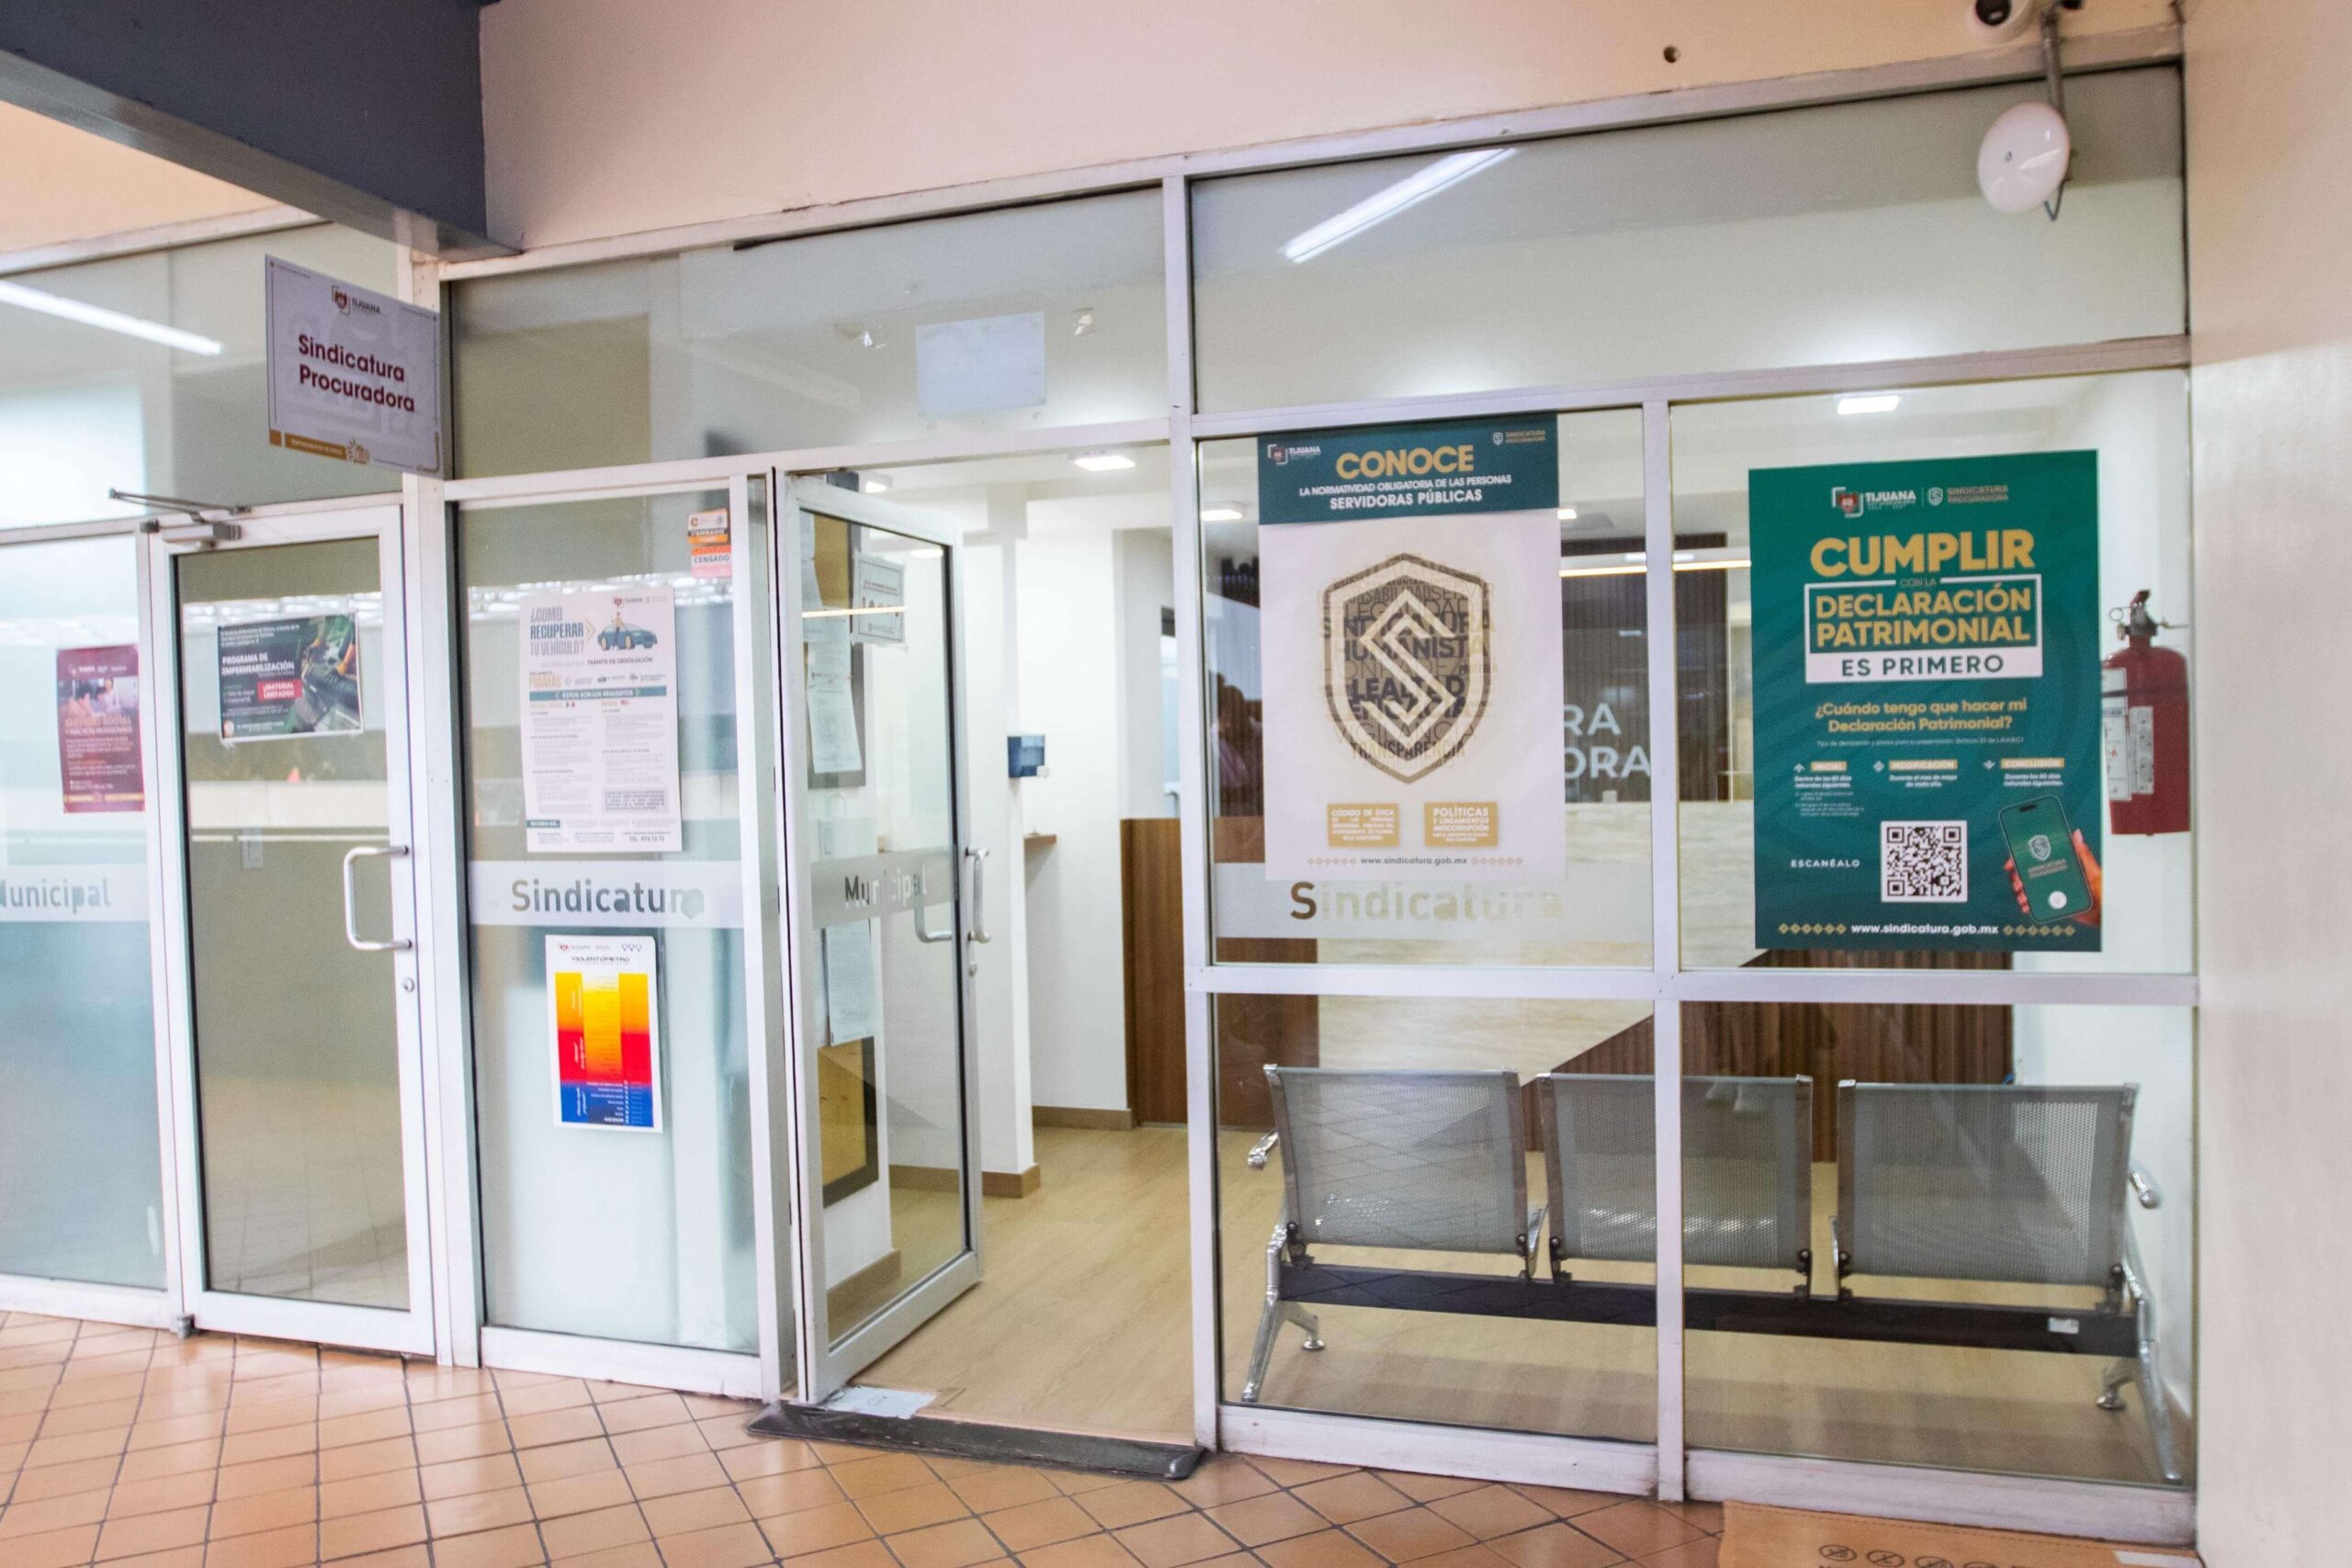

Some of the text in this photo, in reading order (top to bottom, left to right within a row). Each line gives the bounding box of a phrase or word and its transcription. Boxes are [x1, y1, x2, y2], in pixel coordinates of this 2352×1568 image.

[298, 333, 405, 382] Sindicatura
[299, 364, 415, 412] Procuradora
[1288, 446, 1321, 456] TIJUANA
[1336, 445, 1475, 479] CONOCE
[1299, 474, 1512, 497] LA NORMATIVIDAD OBLIGATORIA DE LAS PERSONAS
[1947, 485, 2009, 495] SINDICATURA
[1329, 488, 1484, 510] SERVIDORAS PÚBLICAS
[1865, 490, 1917, 503] TIJUANA
[694, 555, 729, 564] CENSADO
[1809, 528, 2036, 578] CUMPLIR
[1899, 577, 1938, 587] CON LA
[1815, 581, 2031, 619] DECLARACIÓN
[530, 622, 584, 640] RECUPERAR
[1815, 615, 2030, 649] PATRIMONIAL
[221, 652, 268, 665] PROGRAMA DE
[1841, 654, 2005, 677] ES PRIMERO
[221, 660, 295, 676] IMPERMEABILIZACIÓN
[1815, 696, 2028, 719] ¿Cuándo tengo que hacer mi
[1827, 713, 2014, 733] Declaración Patrimonial?
[1815, 761, 1844, 771] INICIAL
[1894, 760, 1955, 770] MODIFICACIÓN
[2006, 758, 2062, 769] CONCLUSIÓN
[1331, 808, 1361, 817] CÓDIGO
[1433, 806, 1489, 817] POLÍTICAS
[1433, 824, 1489, 832] ANTICORRUPCIÓN
[1440, 817, 1489, 825] LINEAMIENTOS
[1361, 857, 1468, 866] www.sindicatura.gob.mx
[1791, 857, 1860, 869] ESCANÉALO
[845, 864, 927, 908] Munipal
[1290, 881, 1561, 920] Sindicatura
[1850, 922, 1999, 937] www.sindicatura.gob.mx
